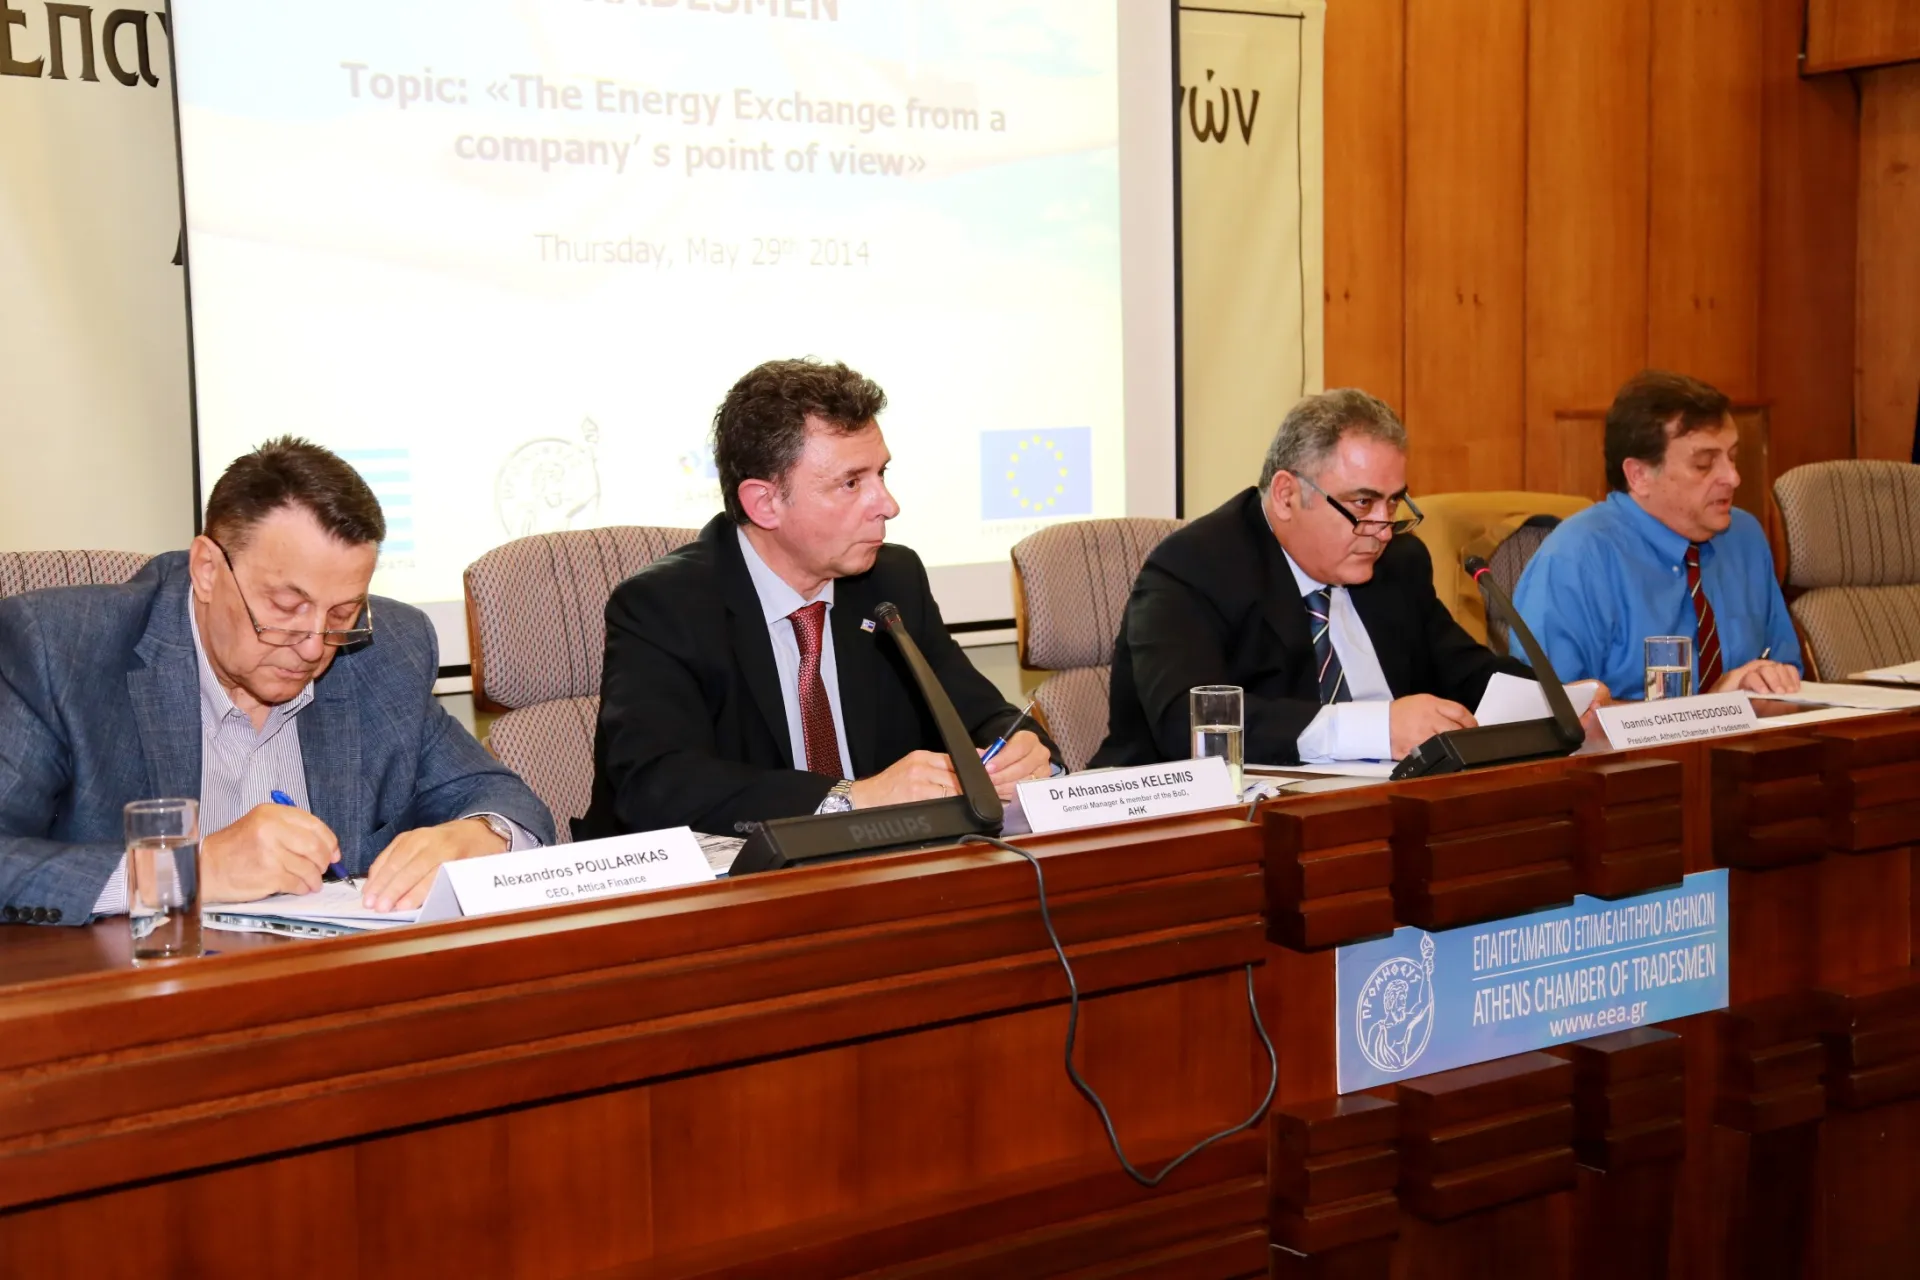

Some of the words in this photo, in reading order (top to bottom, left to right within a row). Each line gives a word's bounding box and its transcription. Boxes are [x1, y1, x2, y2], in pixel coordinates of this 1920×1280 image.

[0, 0, 168, 88] Επα
[340, 61, 467, 110] Topic:
[486, 73, 583, 110] «The
[595, 78, 722, 126] Energy
[733, 86, 897, 134] Exchange
[905, 97, 979, 132] from
[990, 106, 1006, 132] a
[1180, 69, 1260, 146] ών
[651, 141, 671, 168] s
[685, 137, 775, 178] point
[784, 140, 820, 173] of
[829, 143, 927, 177] view»
[533, 231, 674, 270] Thursday,
[685, 234, 741, 272] May
[809, 236, 871, 266] 2014
[1621, 718, 1654, 730] Ioannis
[1654, 705, 1743, 726] CHATZITHEODOSIOU
[1659, 731, 1681, 741] Athens
[1681, 727, 1709, 738] Chamber
[1710, 725, 1717, 734] of
[1717, 722, 1751, 732] Tradesmen
[1049, 788, 1064, 801] Dr
[1067, 779, 1140, 798] Athanassios
[1140, 770, 1194, 788] KELEMIS
[1062, 802, 1089, 813] General
[1089, 799, 1119, 810] Manager
[1126, 794, 1152, 804] member
[1153, 792, 1161, 800] of
[1161, 790, 1172, 799] the
[849, 815, 932, 843] PHILIPS
[1128, 805, 1148, 816] AHK
[493, 865, 574, 888] Alexandros
[575, 849, 669, 875] POULARIKAS
[545, 886, 575, 899] CEO,
[577, 880, 607, 894] Attica
[608, 874, 647, 888] Finance
[1473, 918, 1572, 972] ΕΠΑΓΓΕΛΜΑΤΙΚΟ
[1574, 901, 1662, 952] ΕΠΙΜΕΛΗΤΗΡΙΟ
[1665, 892, 1716, 934] ΑΘΗΝΩΝ
[1473, 980, 1531, 1027] ATHENS
[1535, 964, 1606, 1013] CHAMBER
[1610, 960, 1629, 997] OF
[1631, 942, 1716, 992] TRADESMEN
[1550, 1001, 1648, 1038] www.eea.gr
